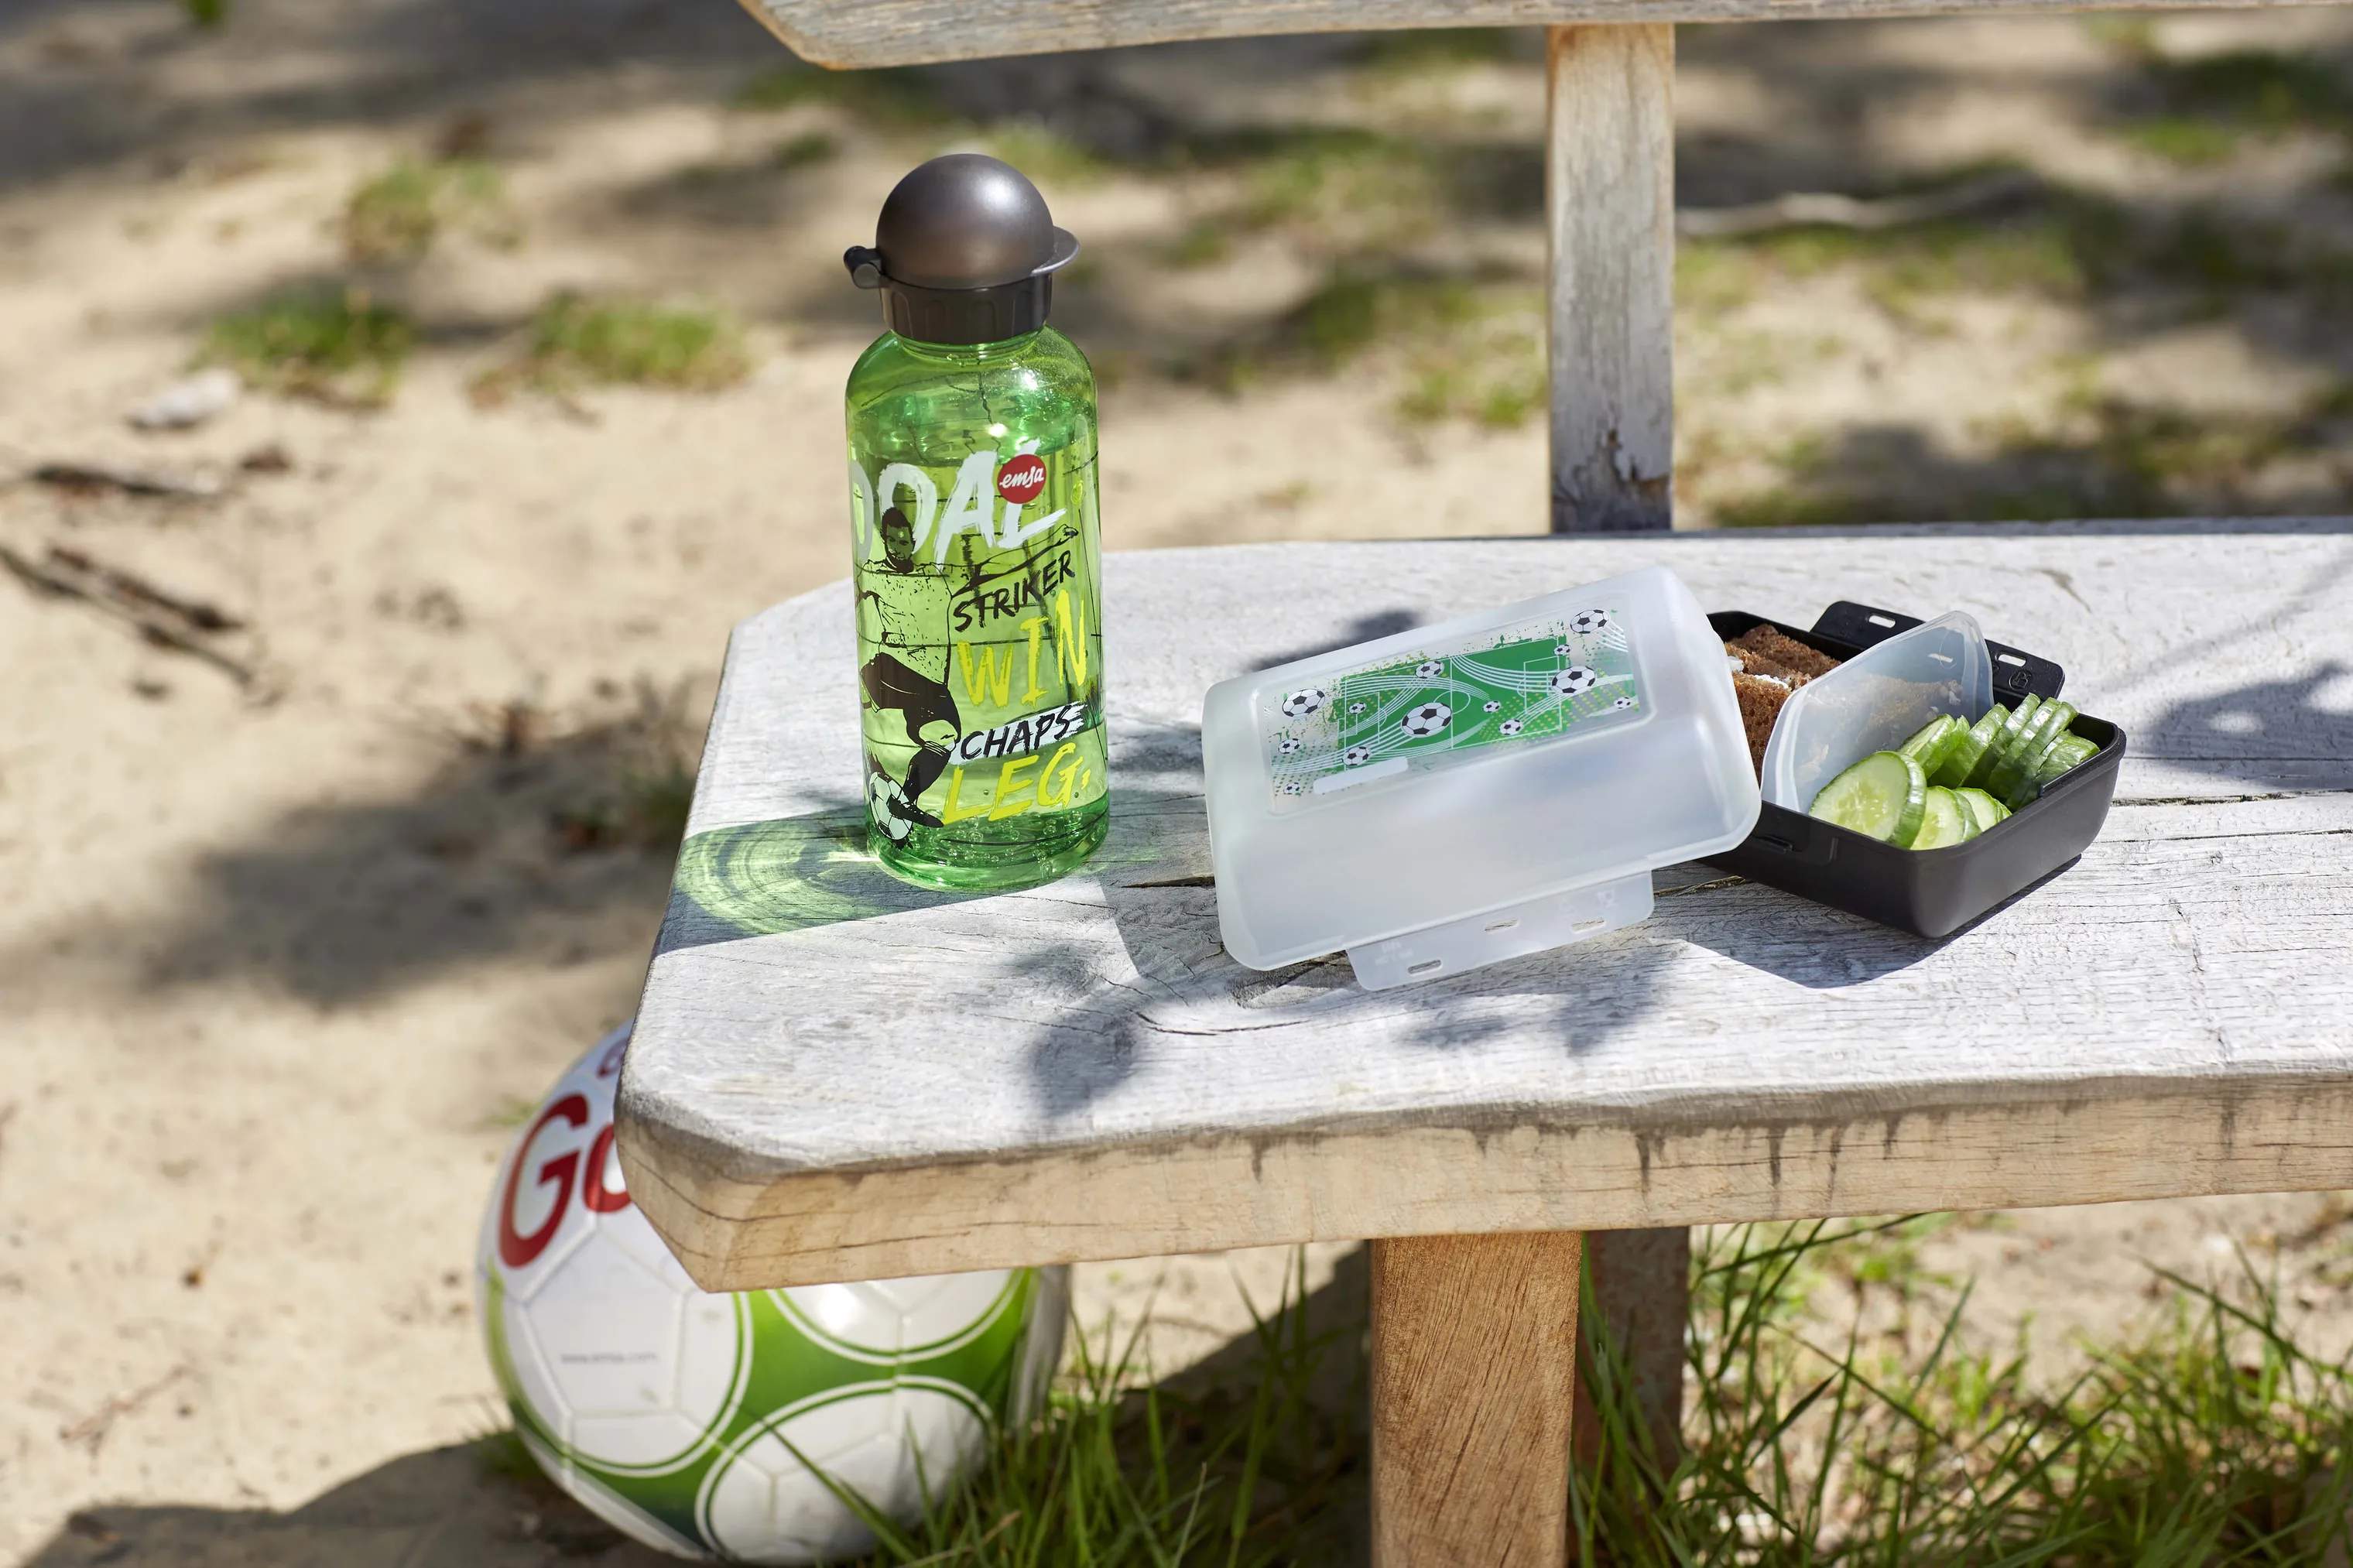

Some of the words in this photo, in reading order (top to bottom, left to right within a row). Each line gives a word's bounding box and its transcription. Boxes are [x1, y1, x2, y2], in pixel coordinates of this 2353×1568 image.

[999, 466, 1043, 489] emsa
[953, 549, 1075, 632] STRIKER
[956, 588, 1087, 707] WIN
[960, 704, 1072, 761] CHAPS
